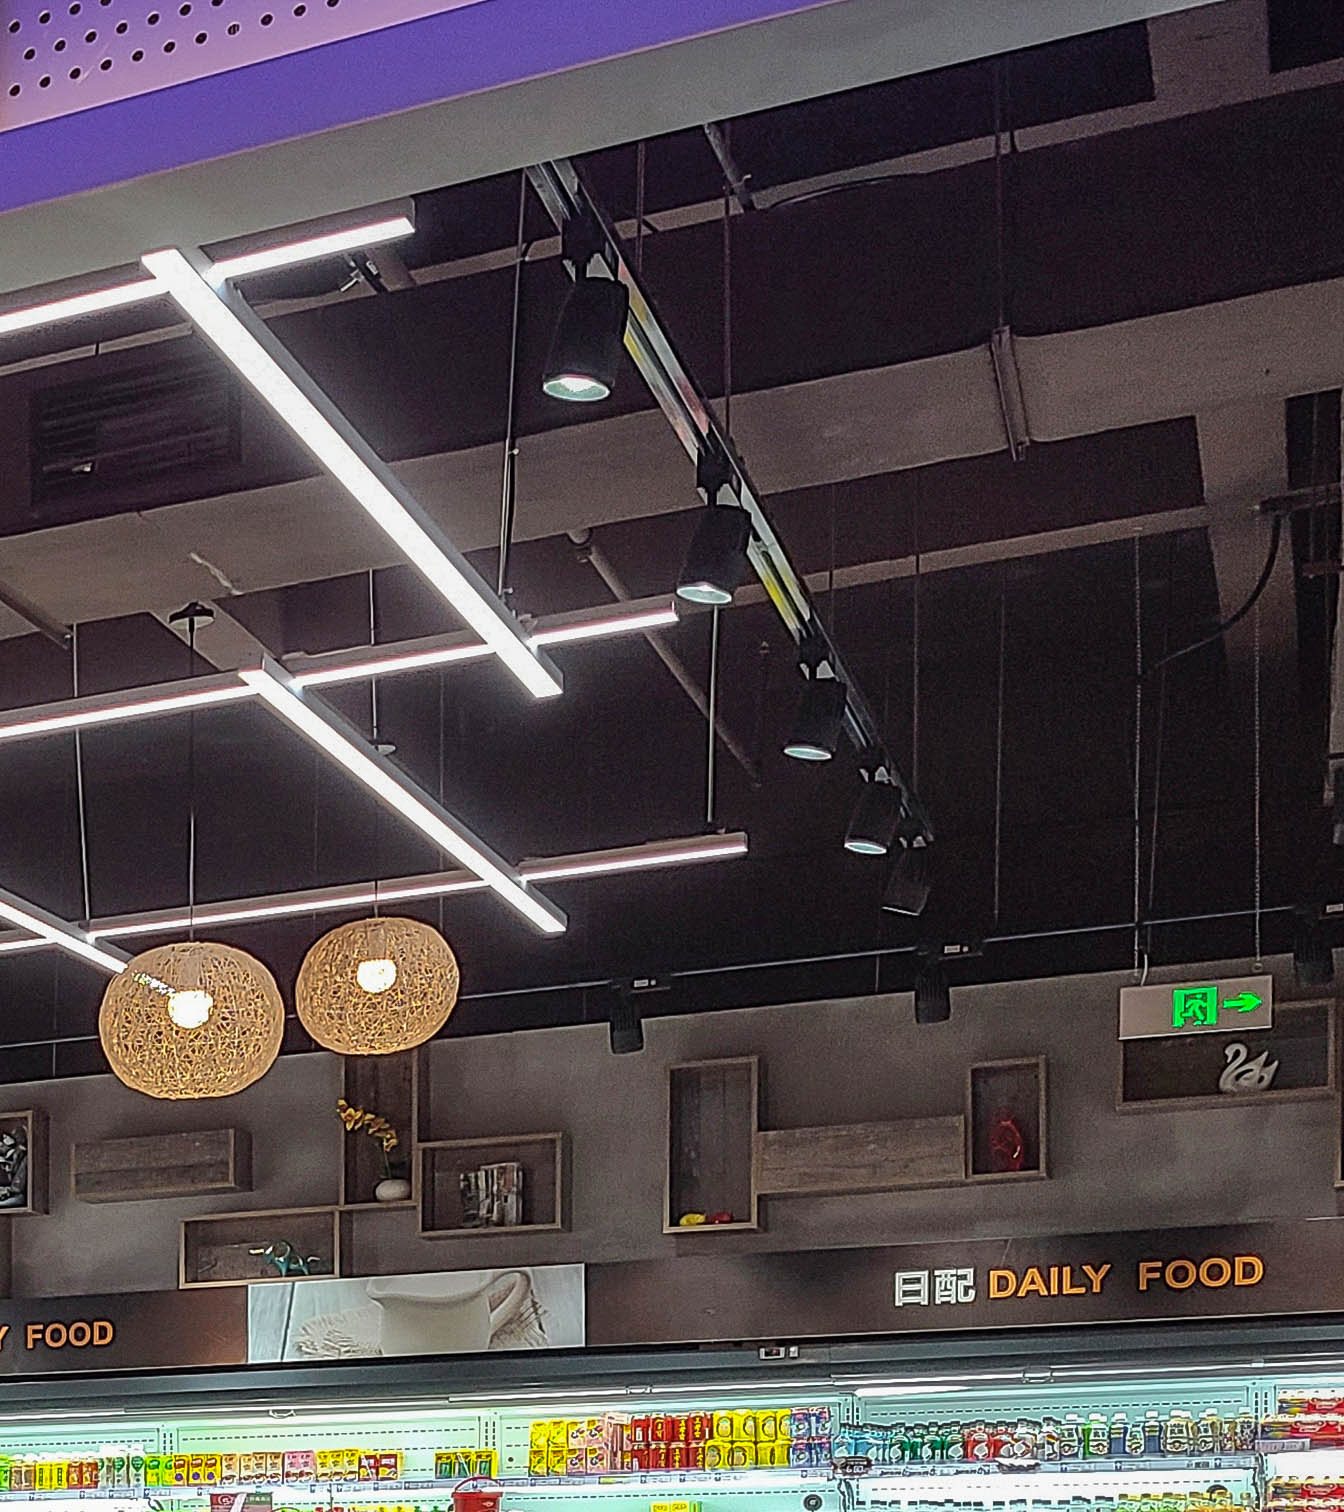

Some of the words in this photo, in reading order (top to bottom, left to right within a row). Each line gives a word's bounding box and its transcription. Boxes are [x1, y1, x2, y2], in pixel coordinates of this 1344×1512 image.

[894, 1268, 974, 1306] 日配
[989, 1264, 1111, 1299] DAILY
[1138, 1256, 1264, 1291] FOOD
[26, 1321, 113, 1349] FOOD
